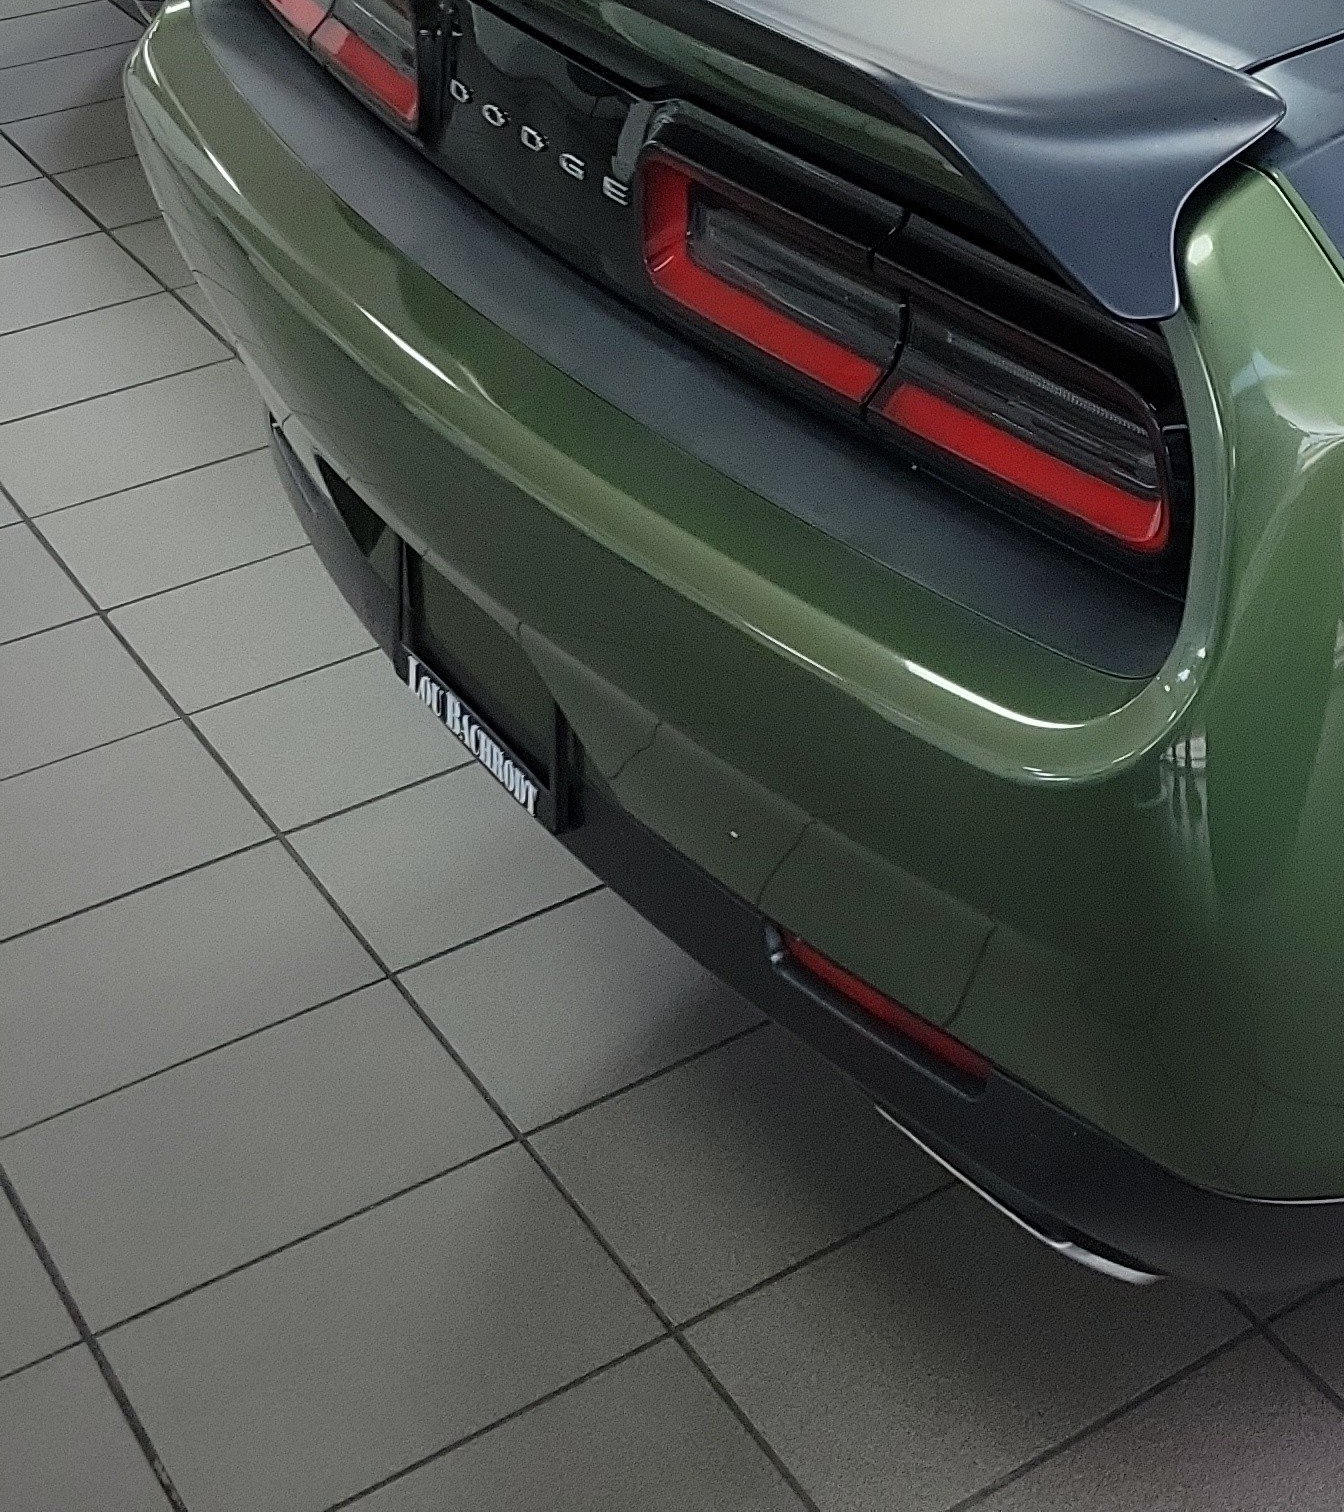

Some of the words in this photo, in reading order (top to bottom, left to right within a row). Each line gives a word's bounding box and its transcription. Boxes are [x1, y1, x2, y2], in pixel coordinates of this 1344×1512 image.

[449, 78, 629, 206] DODGE
[406, 654, 445, 718] LOU
[445, 691, 540, 818] BACHRODT
